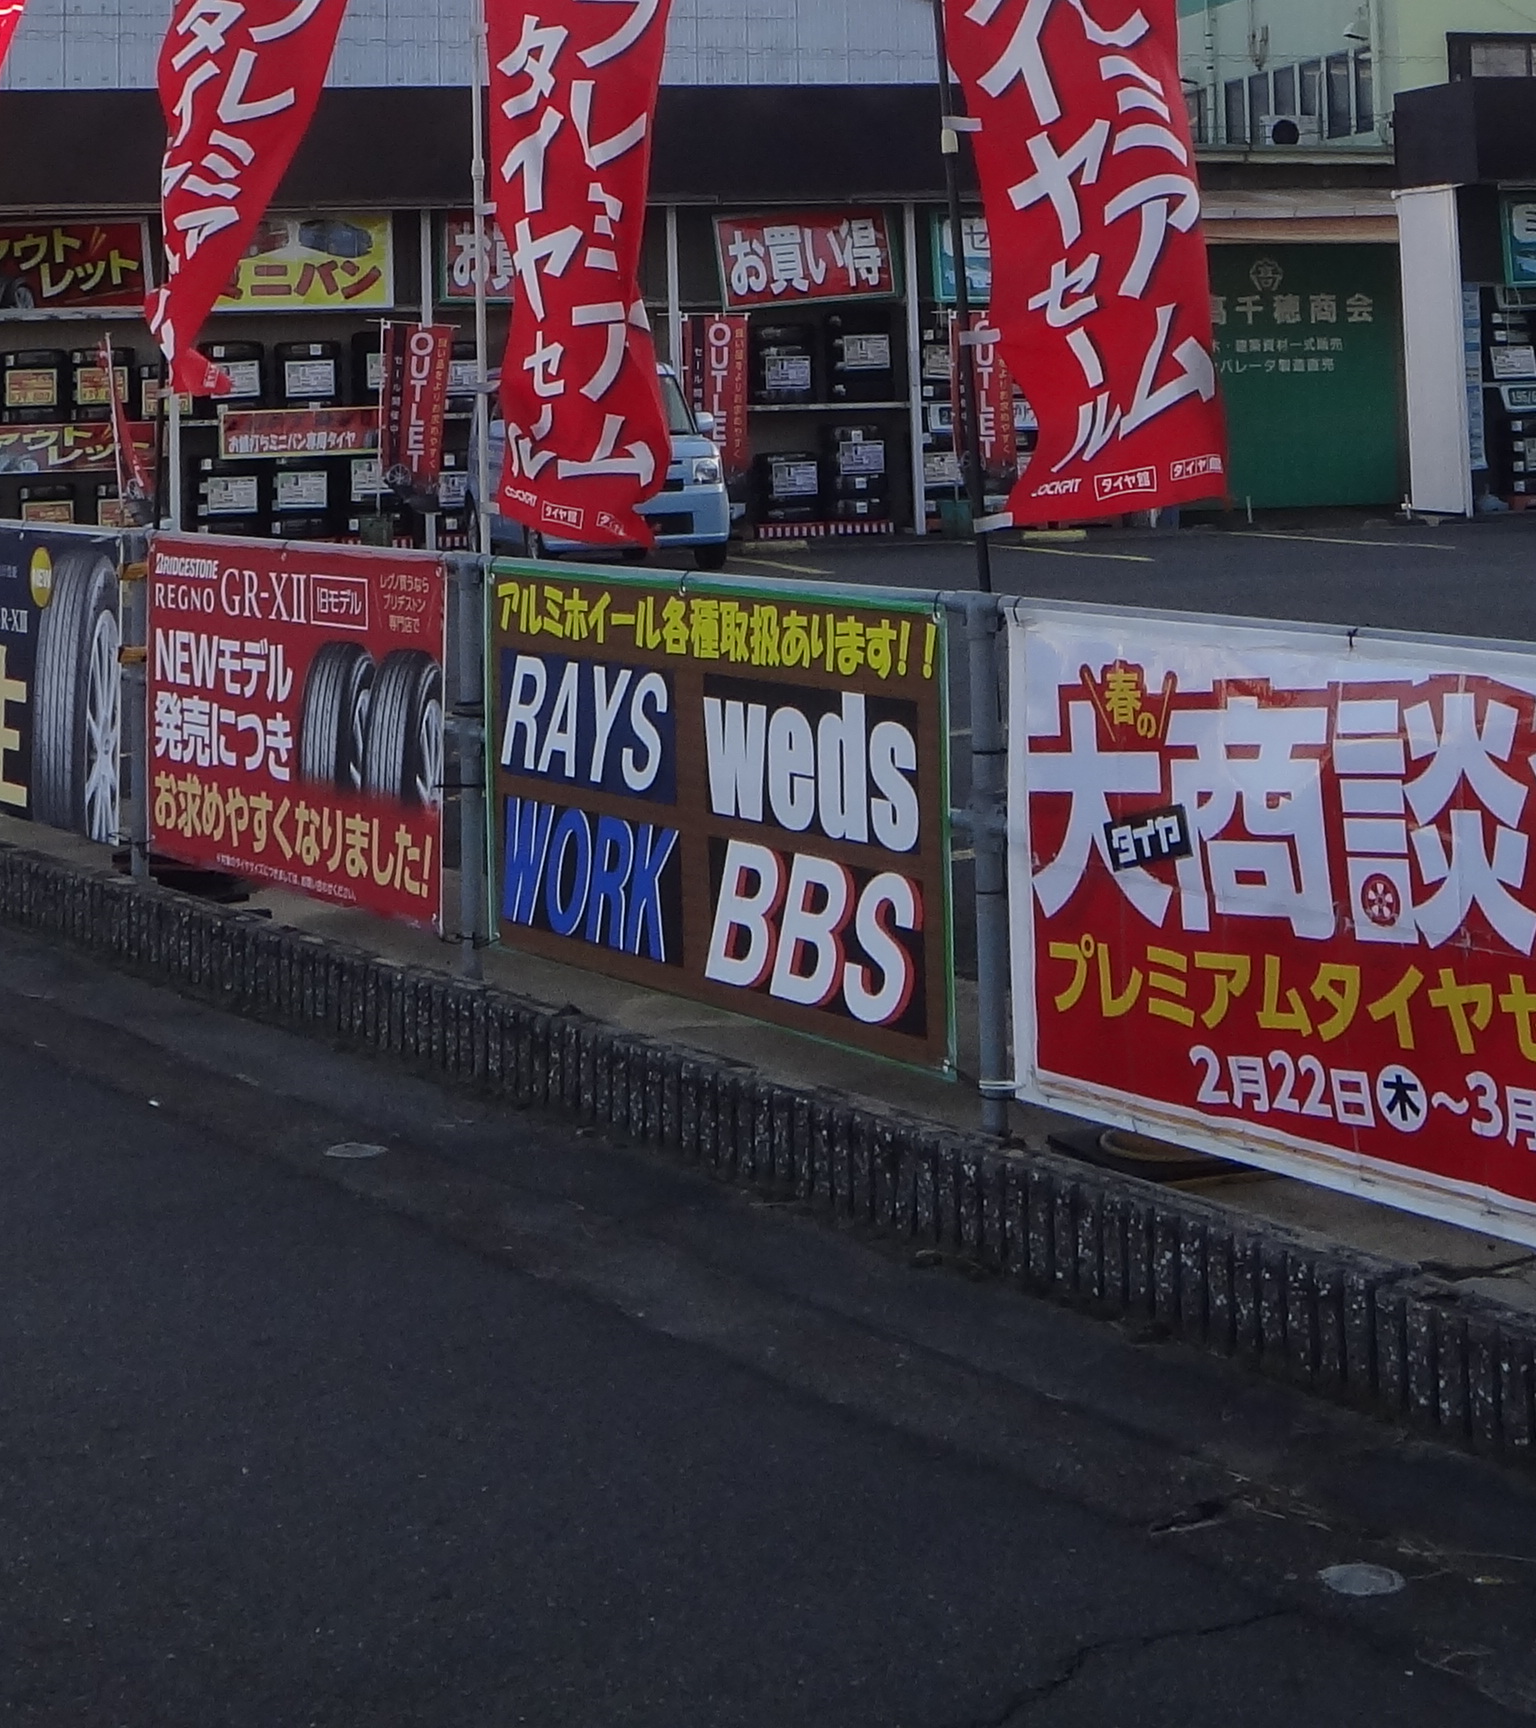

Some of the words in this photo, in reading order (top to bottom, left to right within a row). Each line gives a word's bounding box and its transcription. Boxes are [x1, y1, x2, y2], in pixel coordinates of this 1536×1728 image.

[728, 217, 883, 296] お買い得
[407, 331, 435, 473] OUTLET
[1102, 470, 1152, 493] タイヤ館
[155, 552, 219, 581] BRIDGESTONE
[155, 581, 215, 615] REGNO
[317, 586, 363, 615] 旧モデル
[155, 627, 293, 704] NEWモデル
[1105, 669, 1157, 740] 春の
[154, 690, 294, 782] 発売につき
[501, 654, 669, 792] RAYS
[703, 692, 920, 853] weds
[154, 770, 434, 899] お求めやすくなりました!
[1111, 814, 1184, 865] タイヤ
[503, 795, 680, 963] WORK
[704, 839, 924, 1026] BBS
